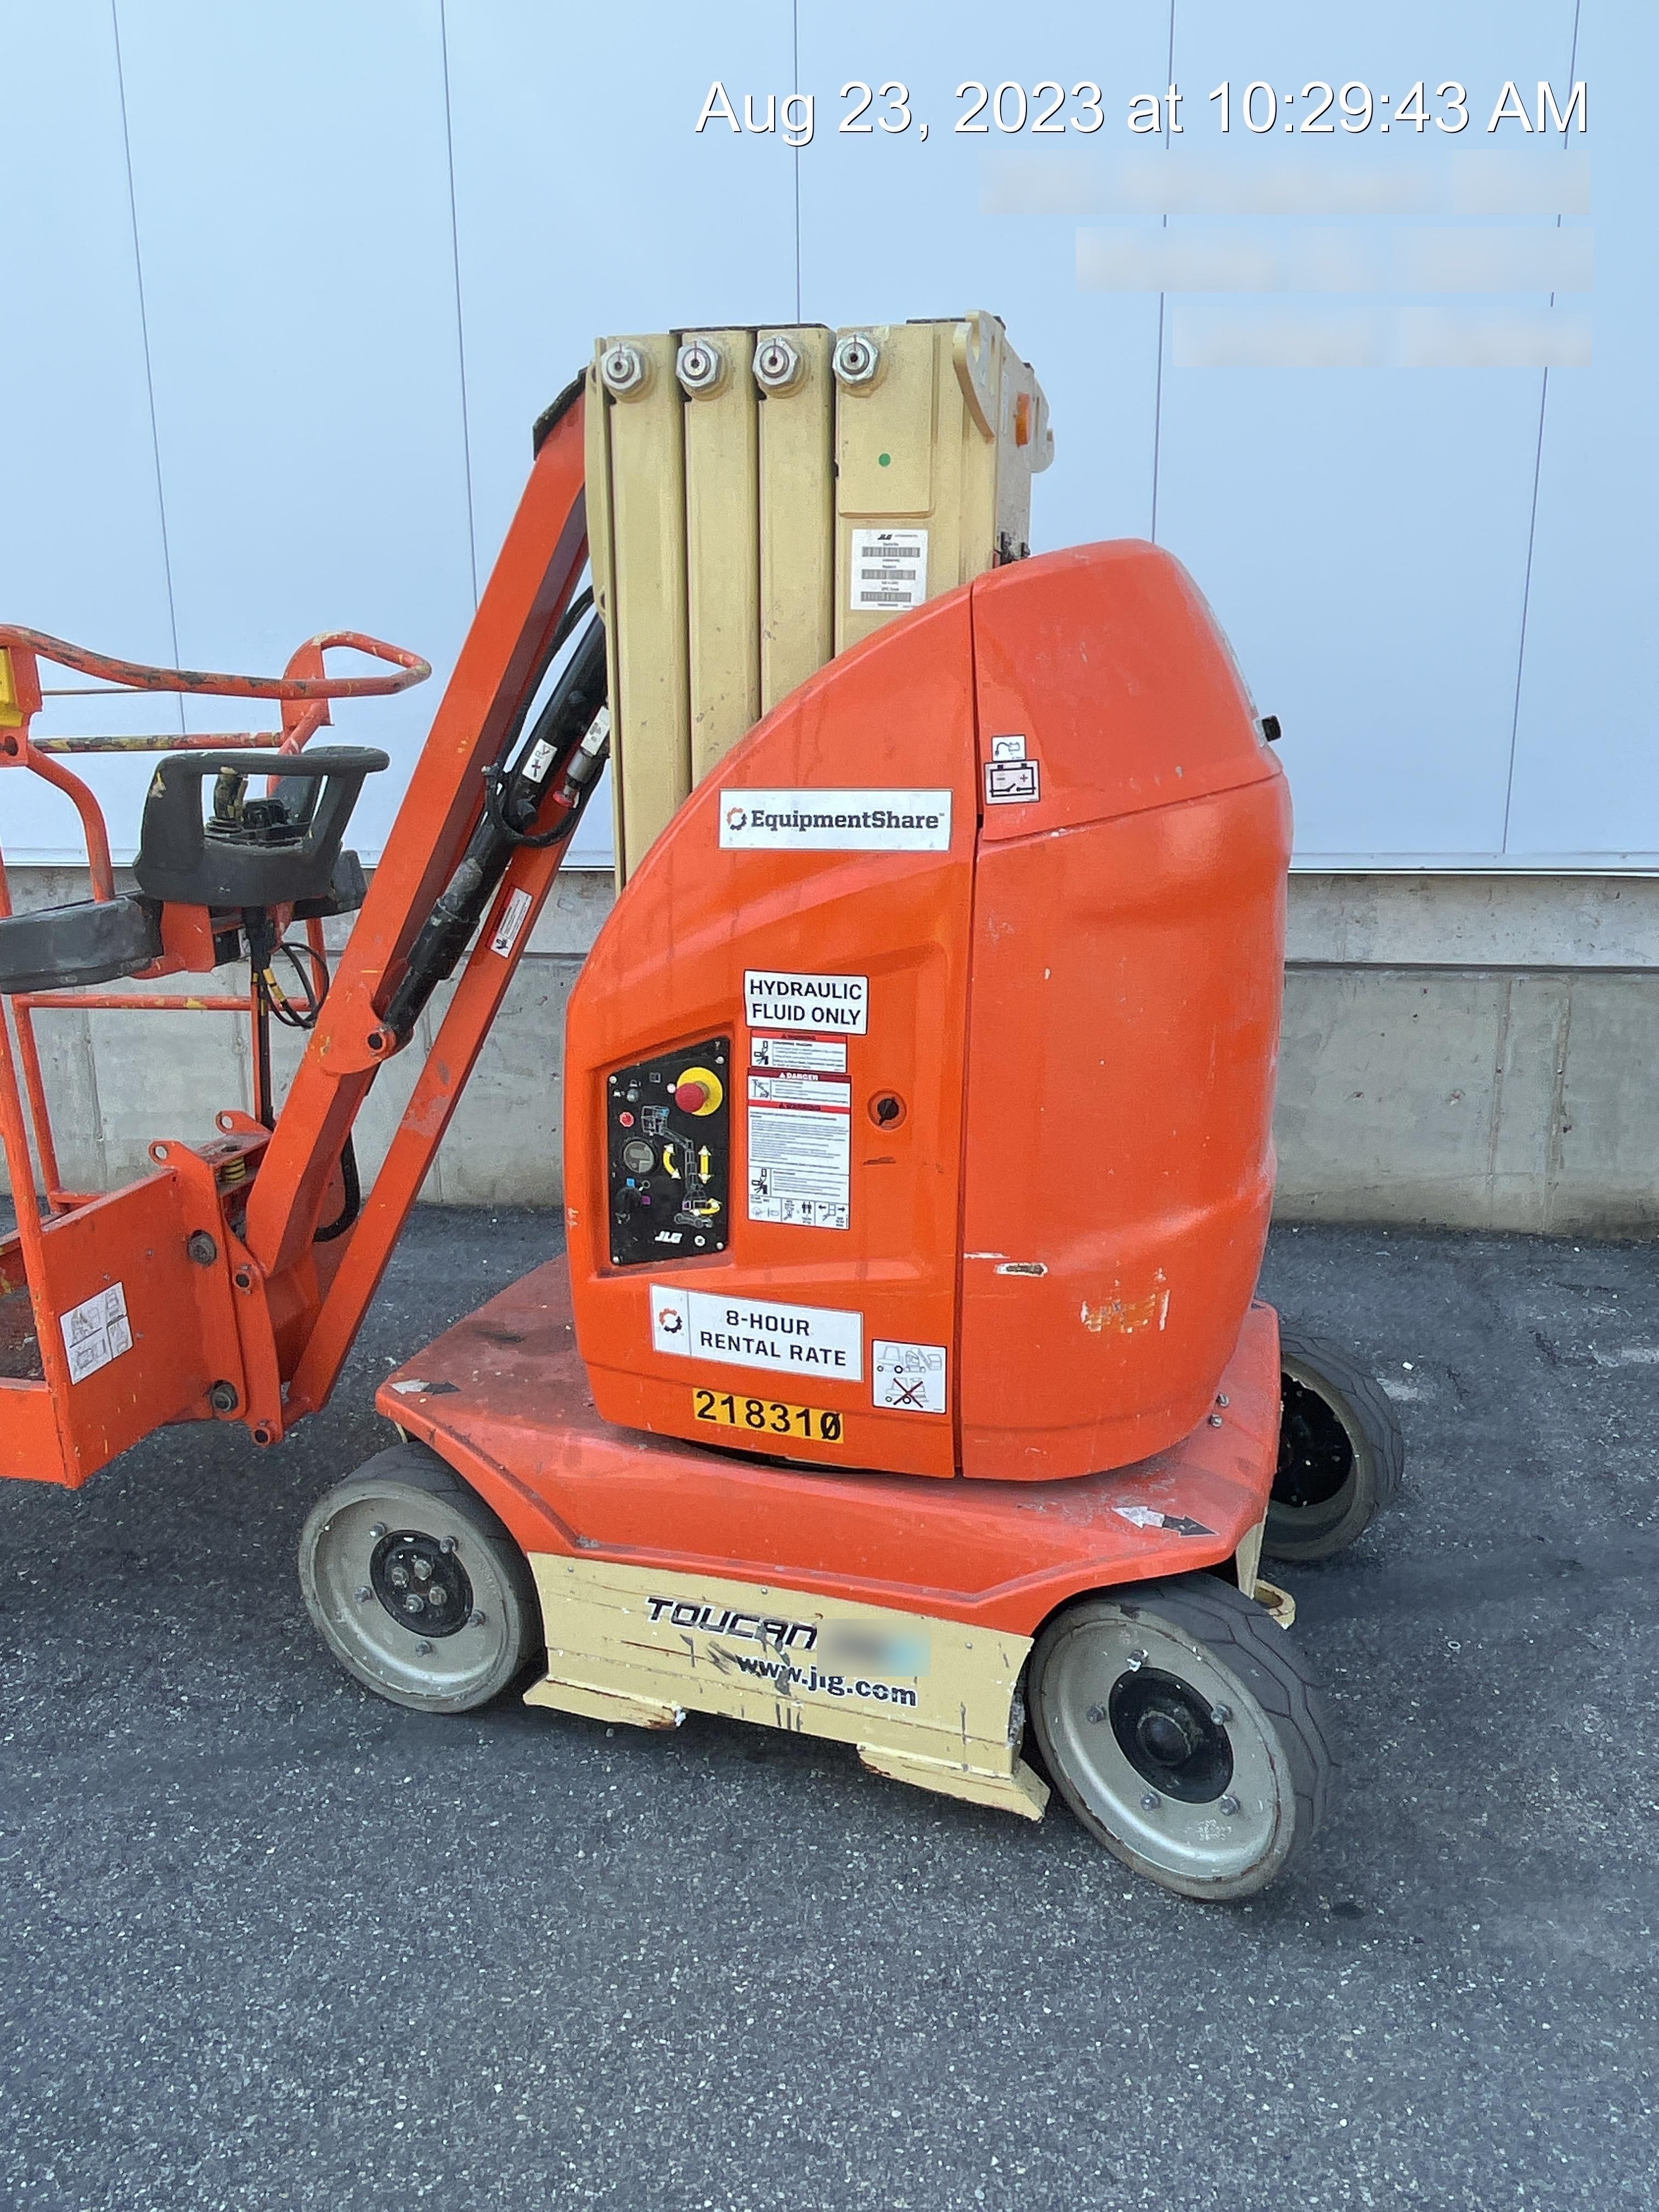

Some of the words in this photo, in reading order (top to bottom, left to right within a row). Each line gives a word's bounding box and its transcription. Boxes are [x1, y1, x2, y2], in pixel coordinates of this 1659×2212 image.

[751, 810, 939, 831] EquipmentShare
[750, 979, 862, 1000] HYDRAULIC
[752, 1003, 805, 1021] FLUID
[811, 1007, 861, 1025] ONLY
[654, 1231, 682, 1243] JLG
[726, 1310, 810, 1336] 8-HOUR
[700, 1331, 781, 1358] RENTAL
[789, 1345, 846, 1366] RATE
